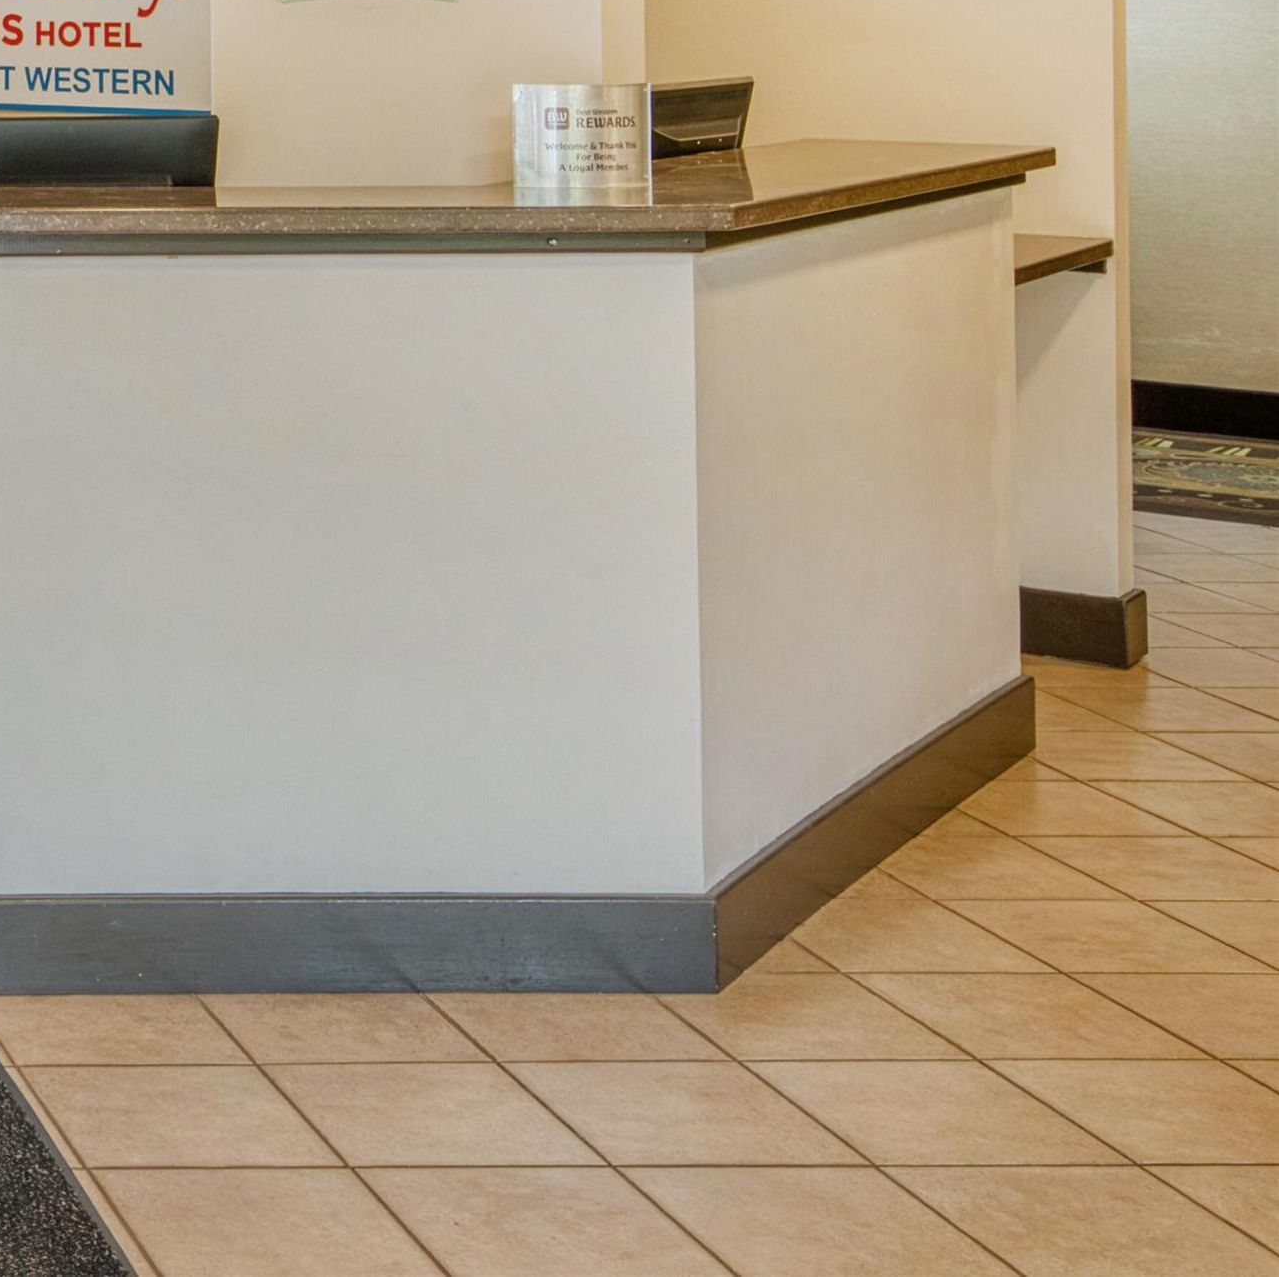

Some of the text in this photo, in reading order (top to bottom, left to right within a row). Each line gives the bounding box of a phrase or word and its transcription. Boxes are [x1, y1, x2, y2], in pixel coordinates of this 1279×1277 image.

[36, 21, 142, 48] HOTEL
[24, 66, 175, 96] WESTERN
[576, 116, 636, 129] REWARDS
[559, 164, 566, 172] A
